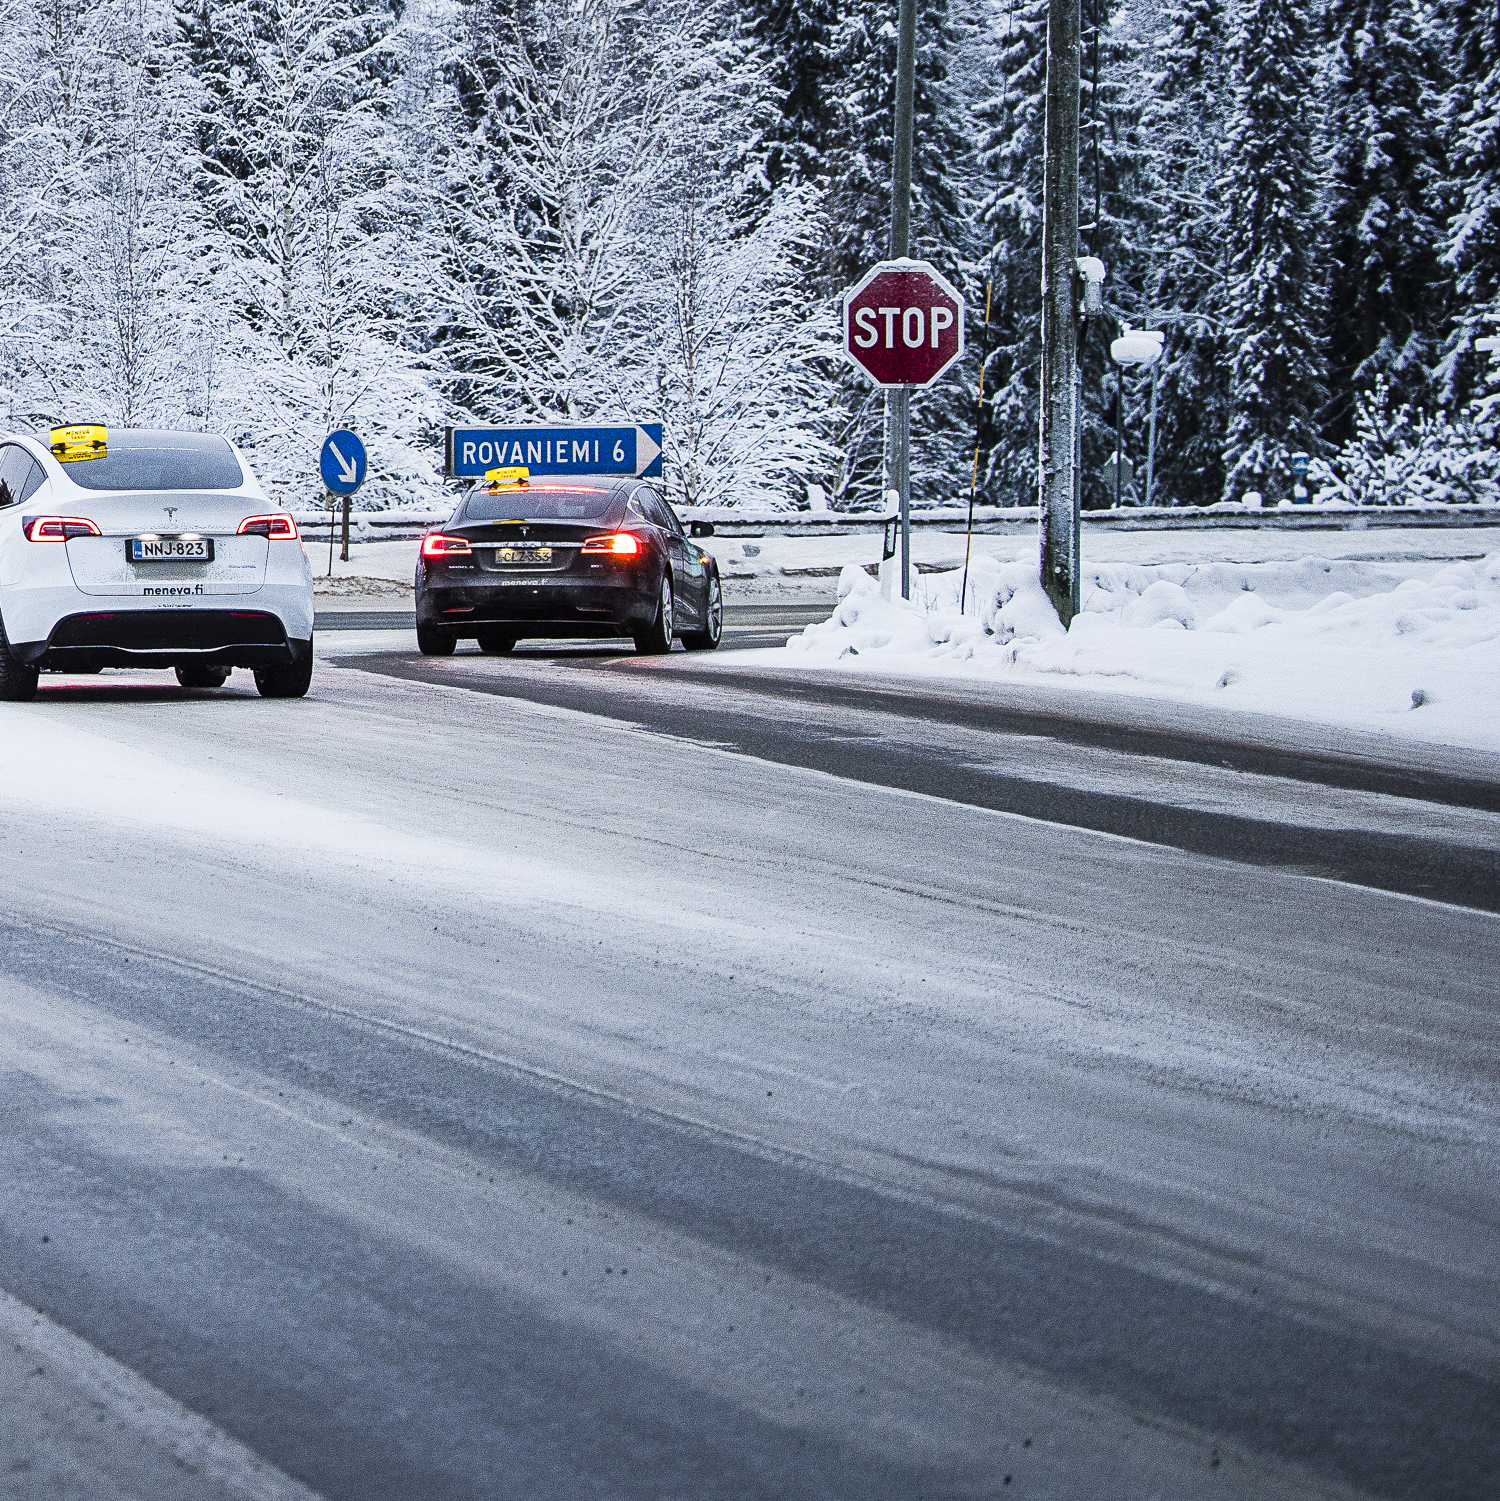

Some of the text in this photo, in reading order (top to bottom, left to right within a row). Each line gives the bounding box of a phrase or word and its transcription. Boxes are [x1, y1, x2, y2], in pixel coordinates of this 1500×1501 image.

[854, 306, 954, 349] STOP
[462, 439, 625, 465] ROVANIEMI 6
[143, 584, 204, 595] meneva.fi
